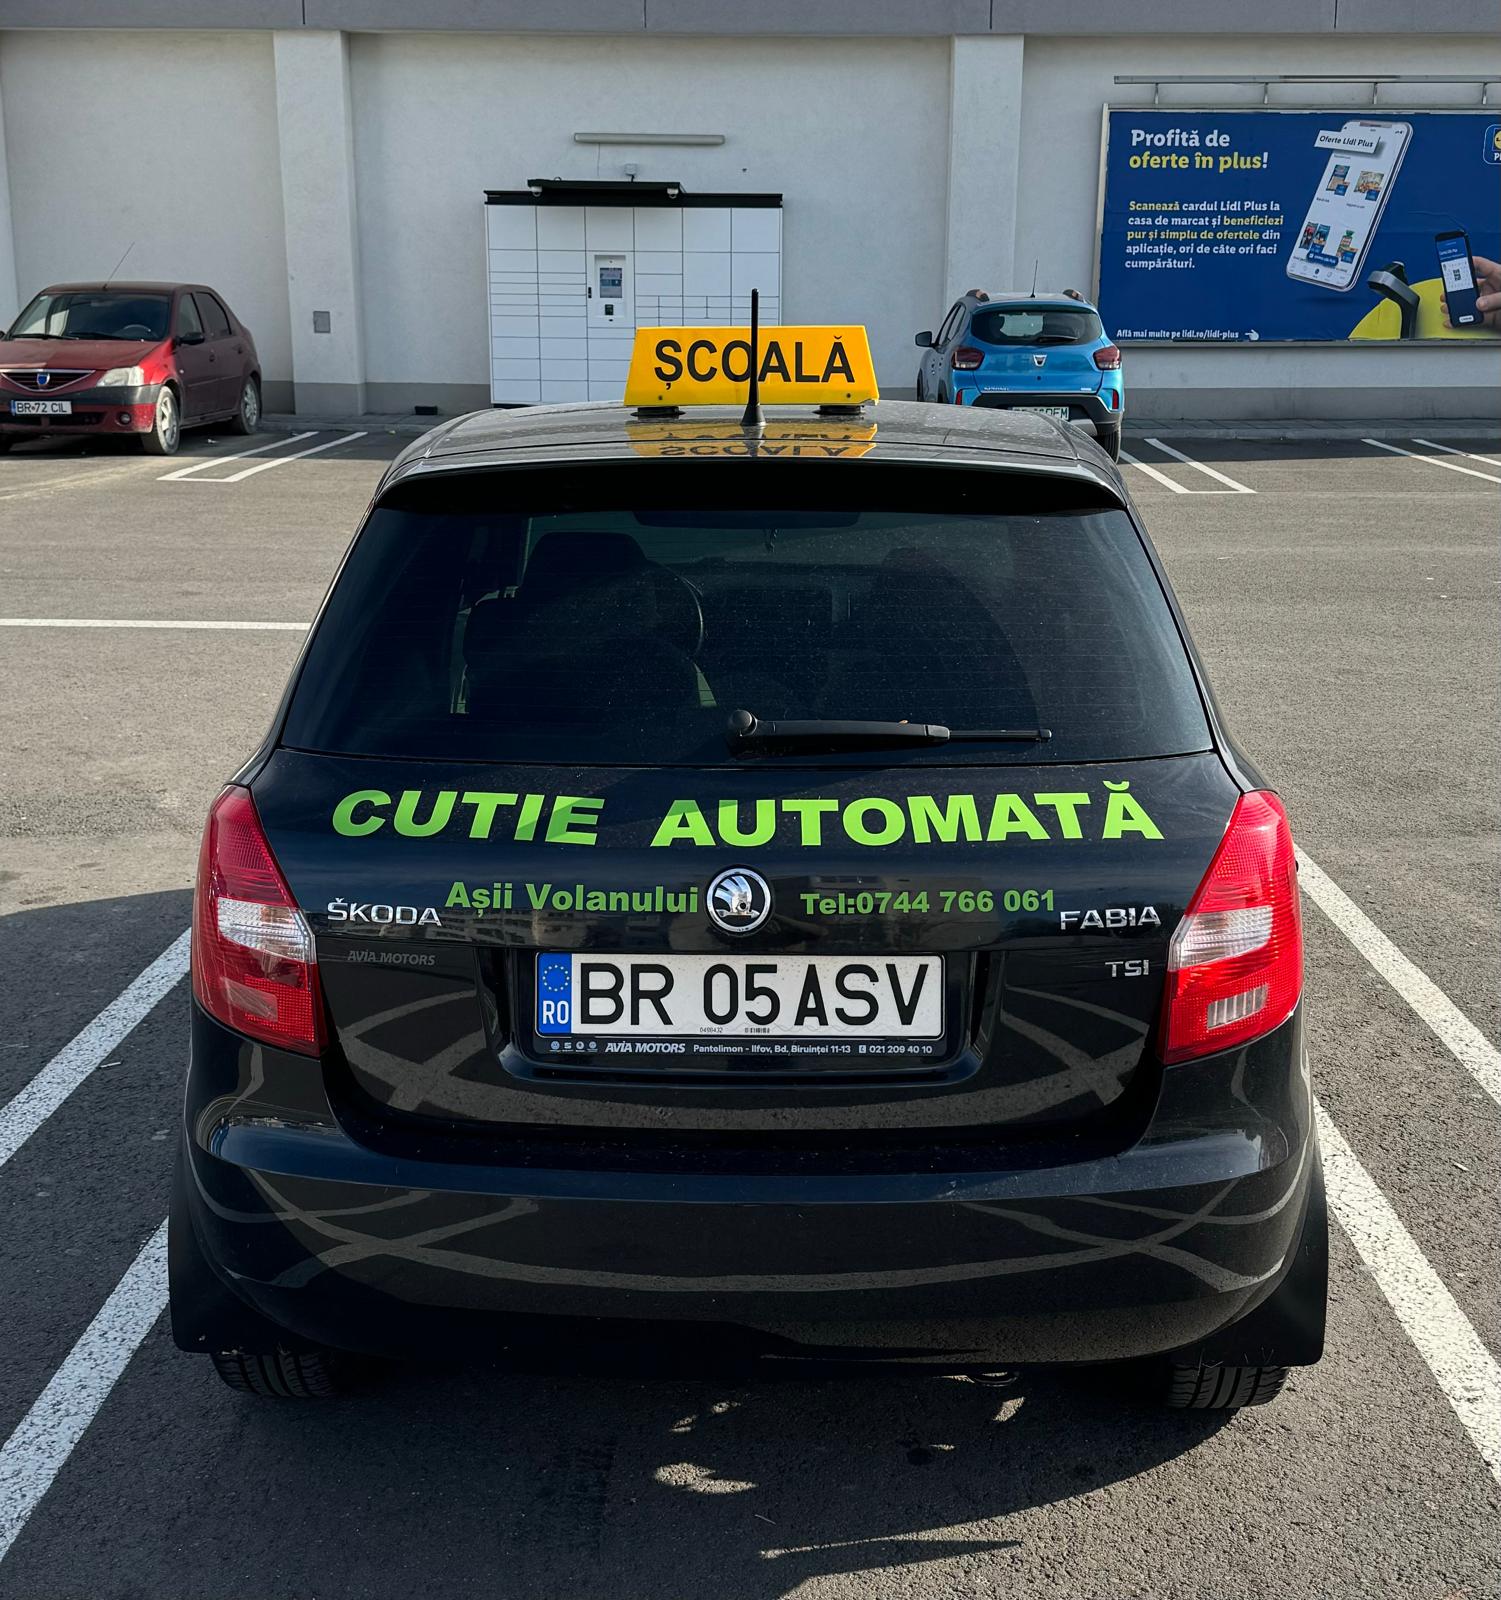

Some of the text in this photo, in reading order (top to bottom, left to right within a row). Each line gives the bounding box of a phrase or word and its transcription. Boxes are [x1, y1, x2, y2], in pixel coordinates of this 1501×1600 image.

[1131, 129, 1231, 147] Profită de
[1319, 135, 1374, 148] Oferte Lidl Plus
[1129, 151, 1268, 173] oferte în plus!
[1129, 201, 1280, 211] Scanează cardul Lidl Plus la
[1128, 215, 1284, 228] casa de marcat și beneficiezi
[1127, 230, 1280, 241] pur și simplu de ofertele din
[1126, 243, 1277, 256] aplicație, ori de câte ori faci
[1125, 258, 1196, 270] cumpărături.
[1116, 329, 1132, 338] Află
[1133, 330, 1147, 338] mai
[1148, 330, 1170, 338] multe
[1171, 331, 1181, 340] pe
[654, 335, 855, 390] ȘCOALĂ
[16, 402, 67, 413] BR 72 CIL
[331, 780, 1166, 847] CUTIE AUTOMATĂ
[445, 881, 699, 918] Așii Volanului
[800, 889, 1055, 916] Tel:0744 766 061
[326, 897, 443, 928] ŠKODA
[1059, 905, 1162, 931] FABIA
[379, 952, 436, 966] MOTORS
[1105, 959, 1150, 978] TSI
[580, 962, 929, 1026] BR 05 ASV
[542, 1000, 570, 1025] RO
[635, 1042, 686, 1053] MOTORS
[693, 1044, 743, 1053] Pantelimon
[751, 1044, 773, 1054] Ilfov,
[774, 1044, 789, 1053] Bd.
[830, 1045, 851, 1054] 11-13
[869, 1045, 933, 1054] 021 209 40 10
